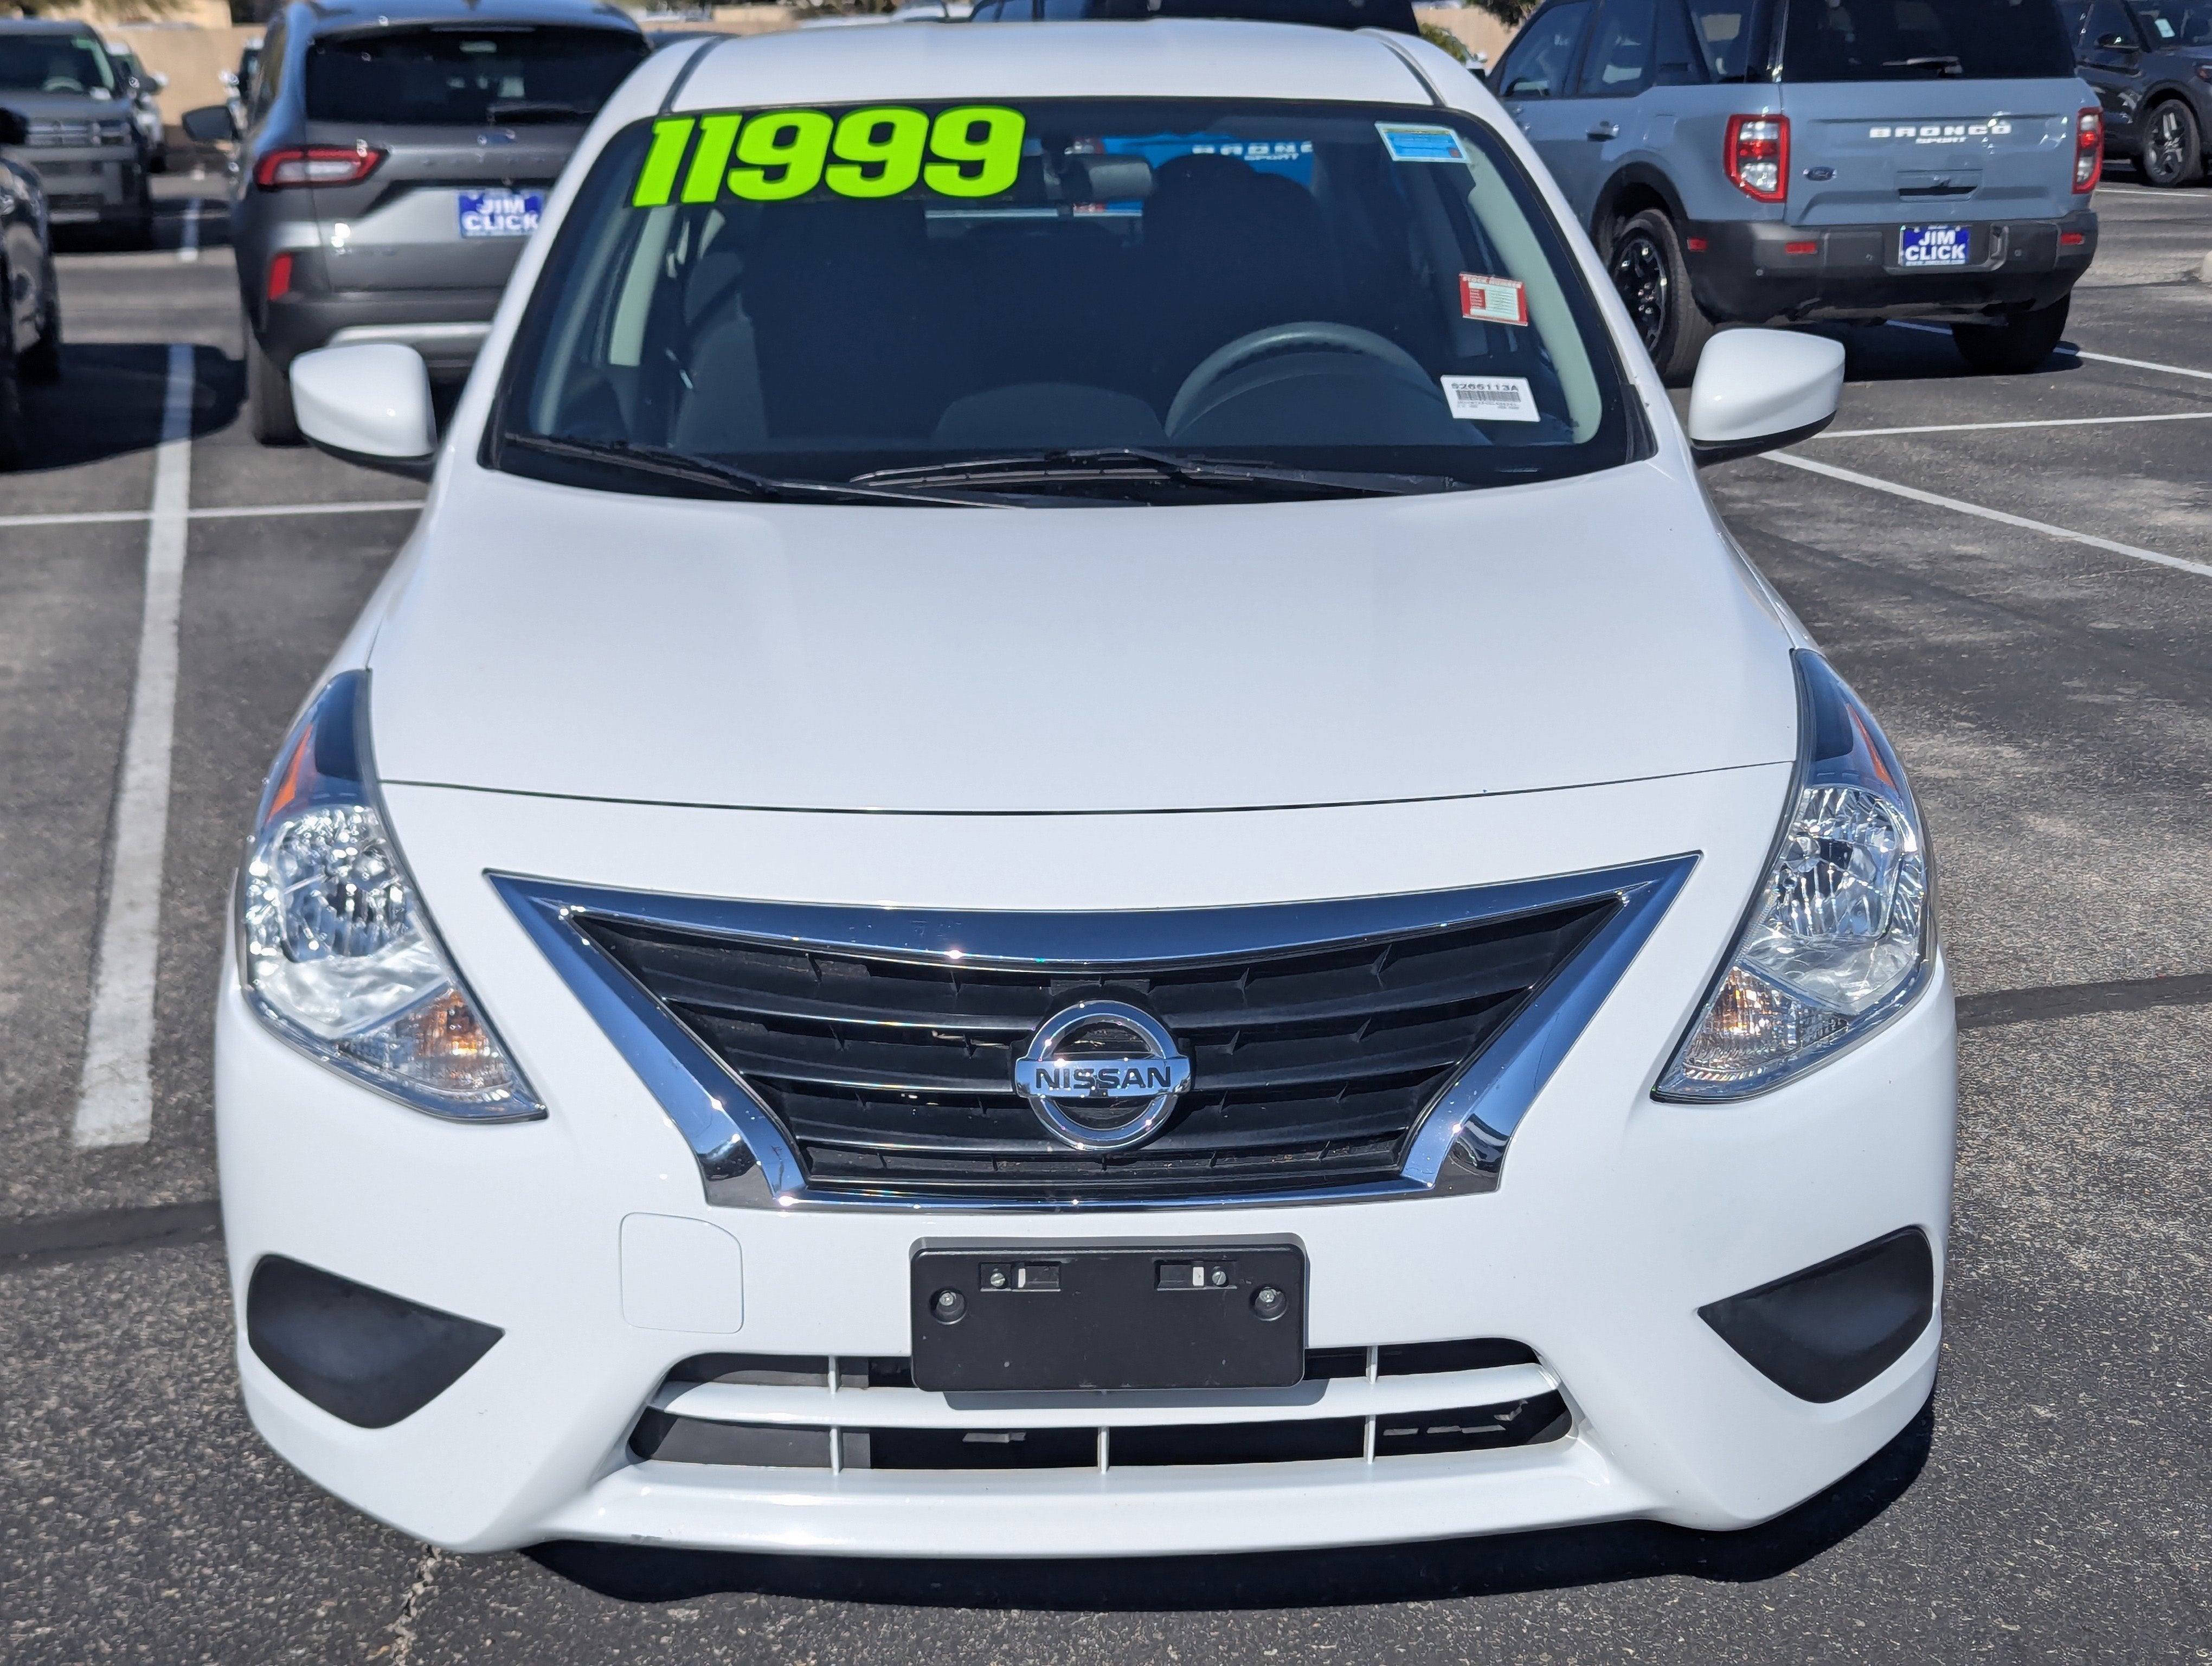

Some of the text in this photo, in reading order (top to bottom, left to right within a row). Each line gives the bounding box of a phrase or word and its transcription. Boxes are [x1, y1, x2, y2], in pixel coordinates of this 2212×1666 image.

[1869, 124, 2012, 138] BRONCO
[1915, 136, 1967, 144] SPORT
[632, 105, 1026, 208] 11999
[476, 196, 525, 214] JIM
[462, 211, 538, 230] CLICK
[1918, 229, 1956, 246] JIM
[1905, 244, 1965, 261] CLICK
[1036, 1066, 1171, 1089] NISSAN
